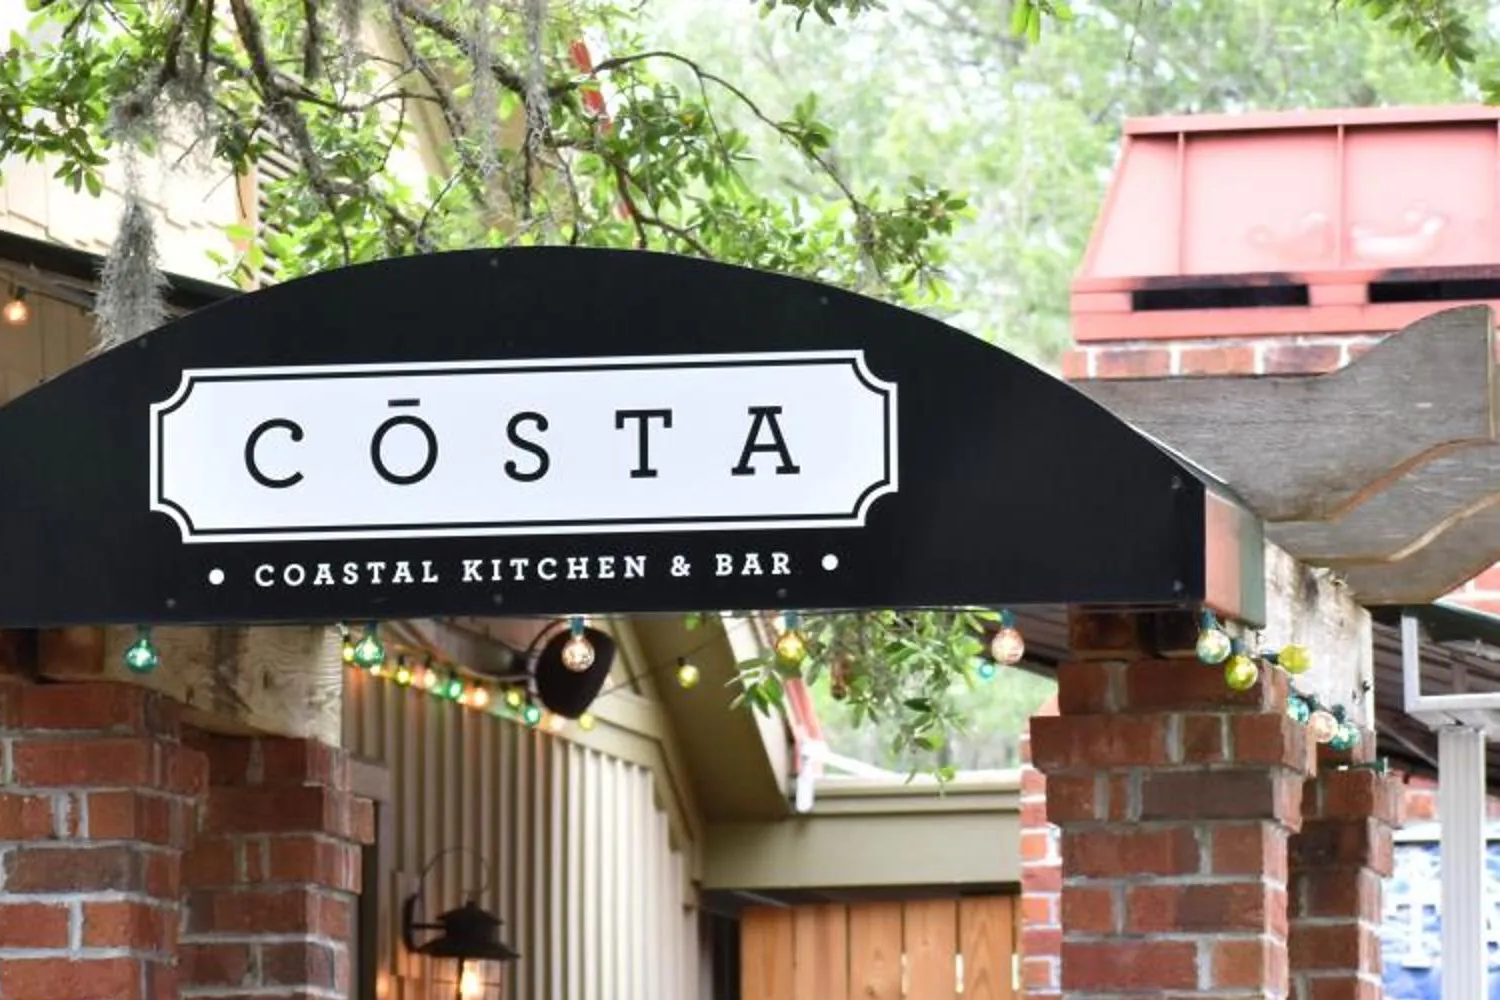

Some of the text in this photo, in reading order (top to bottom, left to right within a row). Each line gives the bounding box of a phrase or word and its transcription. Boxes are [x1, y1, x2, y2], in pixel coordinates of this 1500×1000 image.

[254, 552, 792, 587] COASTAL KITCHEN & BAR
